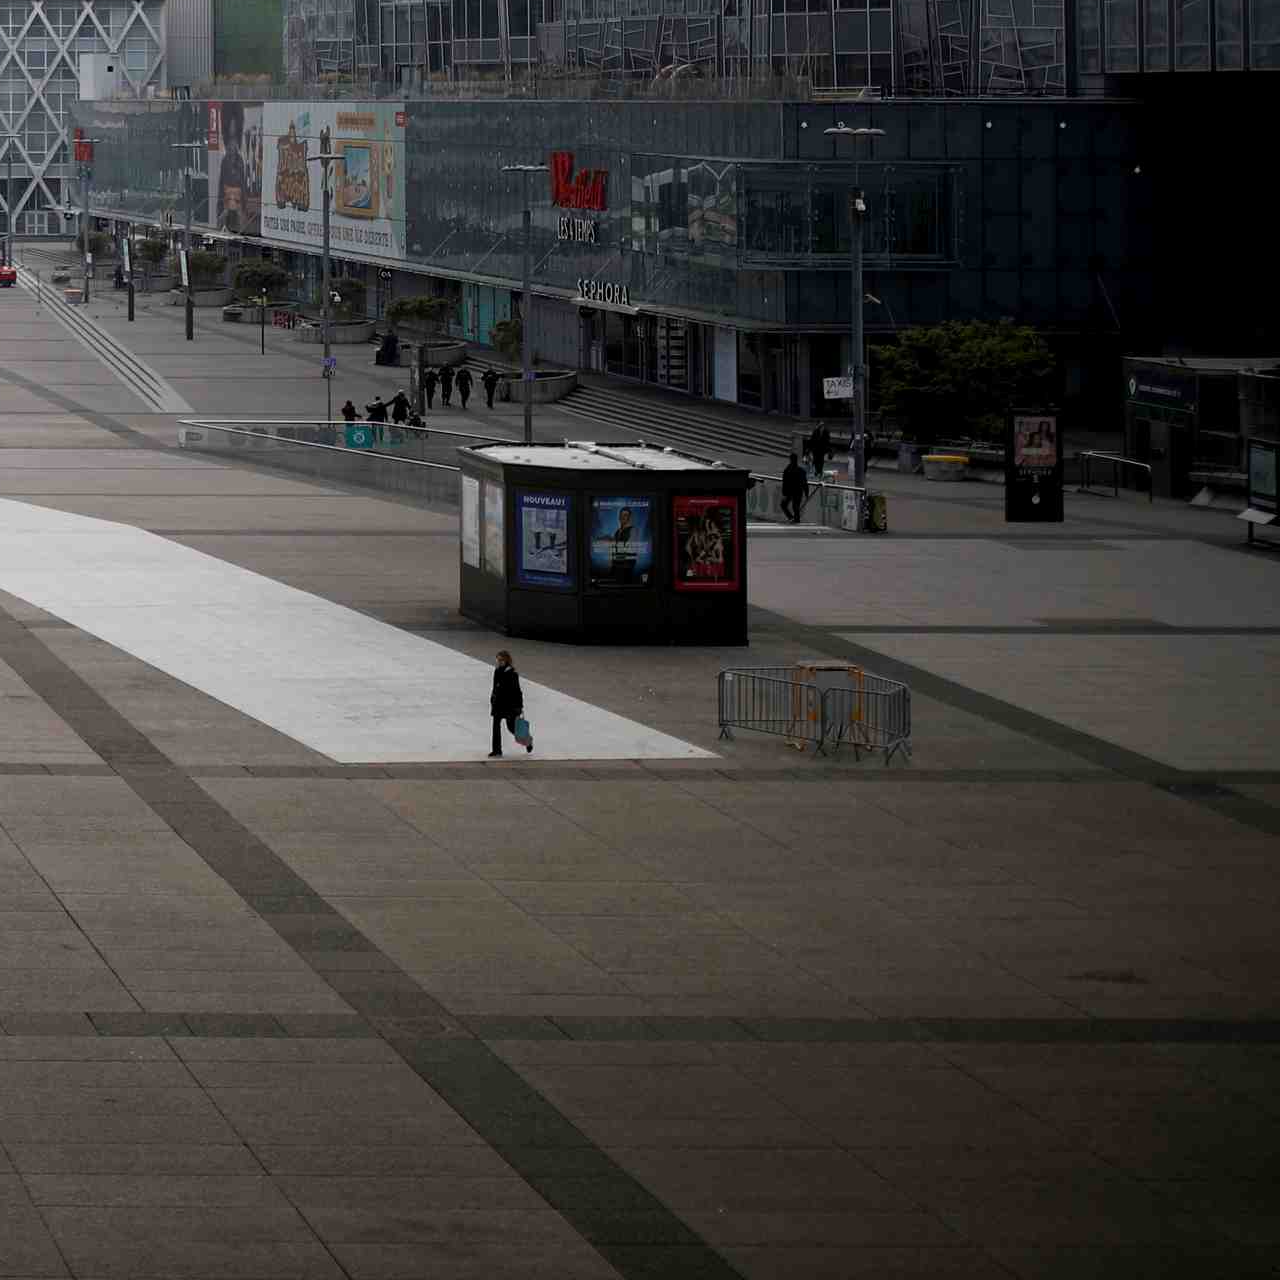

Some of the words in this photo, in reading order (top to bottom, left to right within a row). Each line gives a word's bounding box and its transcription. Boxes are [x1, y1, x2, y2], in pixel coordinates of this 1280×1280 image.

[558, 216, 568, 240] LES
[574, 219, 595, 243] TEMPS
[577, 277, 629, 305] SEPHORA
